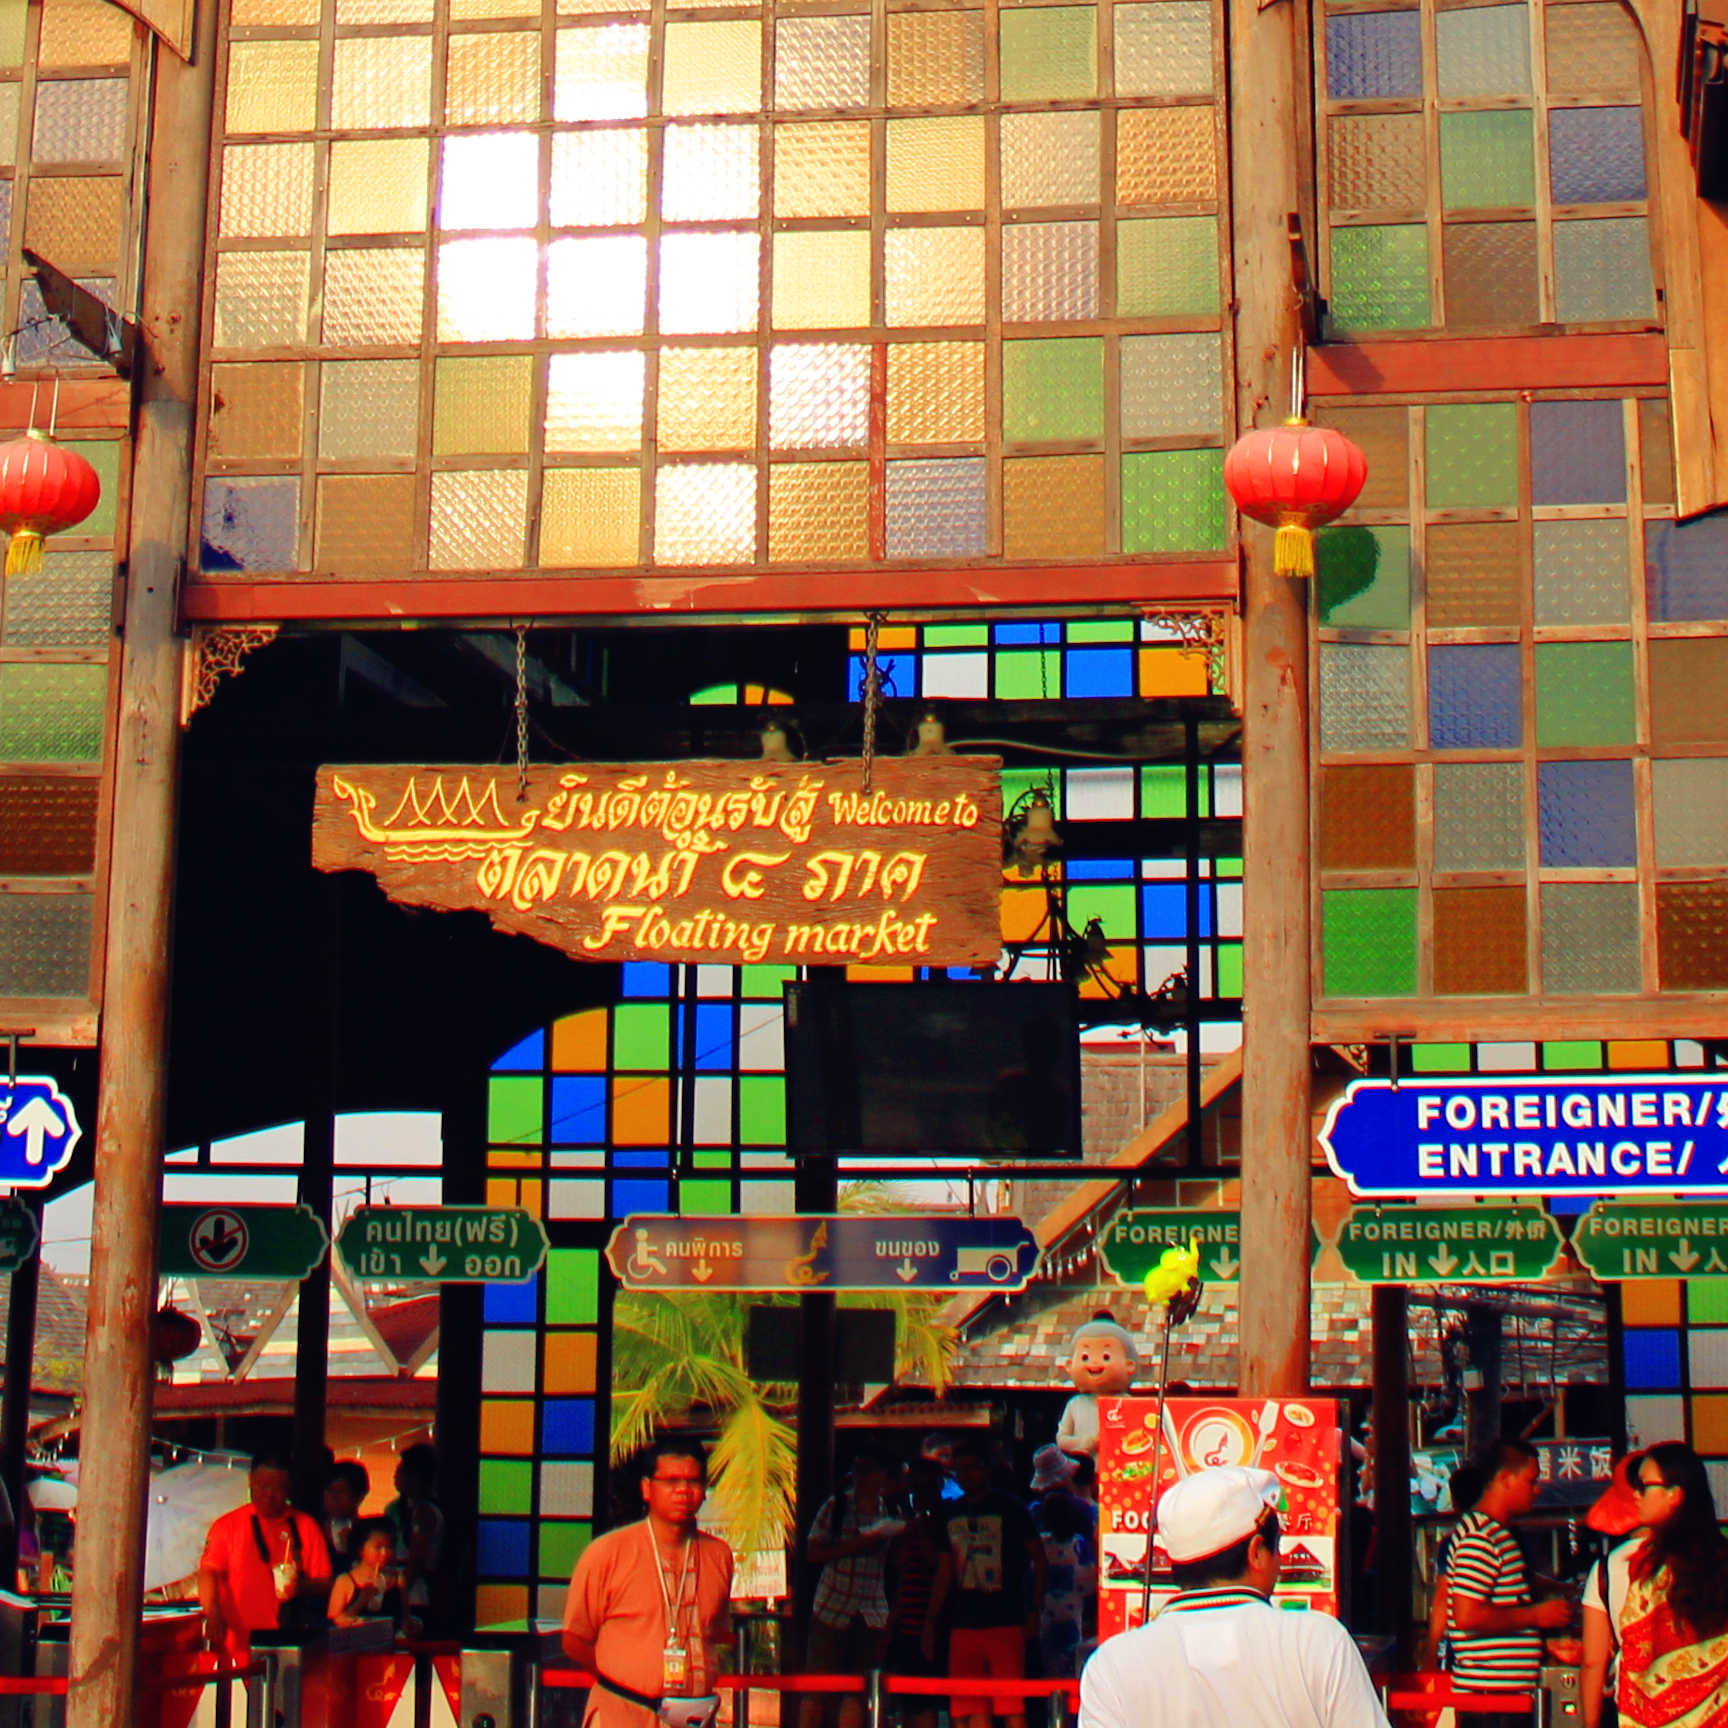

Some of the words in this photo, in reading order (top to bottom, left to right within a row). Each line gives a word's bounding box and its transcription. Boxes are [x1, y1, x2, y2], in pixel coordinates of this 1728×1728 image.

[541, 771, 824, 843] ยินดีต้อนรับสู่
[828, 790, 950, 825] Welcome
[952, 792, 978, 828] to
[476, 829, 728, 910] ตลาดน้ำ
[722, 850, 791, 901] ๔
[803, 850, 927, 901] ภาค
[583, 905, 775, 961] Floating
[784, 909, 938, 959] market
[366, 1211, 519, 1248] คนไทย(ฟรี)
[360, 1247, 401, 1275] เข้า
[464, 1254, 521, 1277] ออก
[665, 1237, 743, 1257] คนพิการ
[1623, 1247, 1659, 1273] IN
[1382, 1252, 1417, 1278] IN
